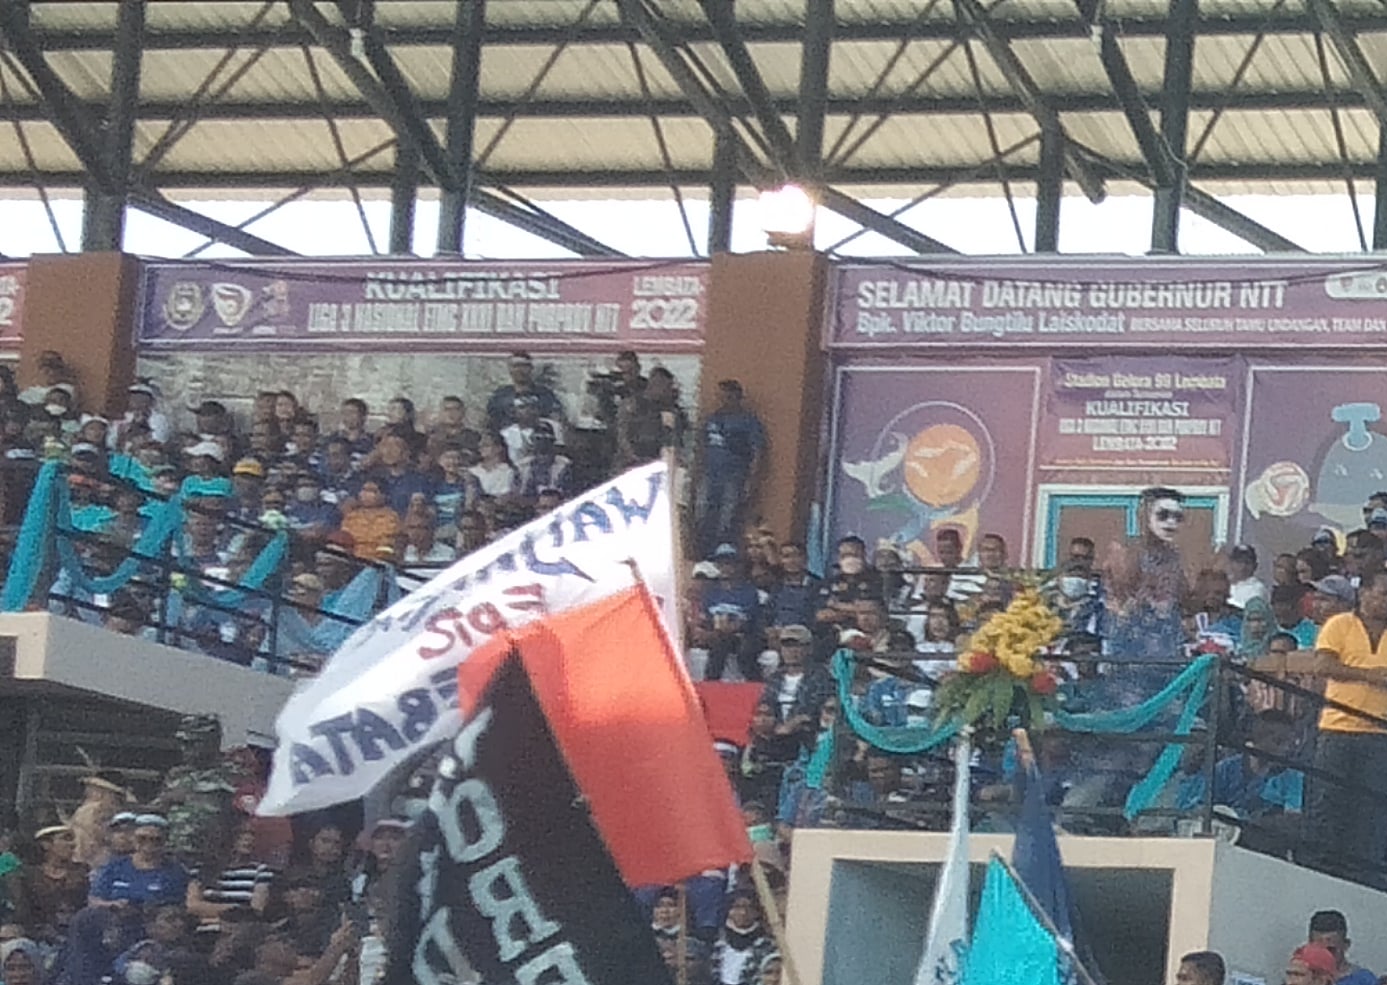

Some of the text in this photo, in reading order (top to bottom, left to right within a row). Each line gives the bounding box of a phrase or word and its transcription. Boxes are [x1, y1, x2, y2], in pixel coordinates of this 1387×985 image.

[366, 271, 560, 302] KUALIFIKASI
[857, 280, 1287, 310] SELAMAT DATANG GUBERNUR NTT
[629, 299, 699, 330] 2022
[902, 310, 955, 333] Viktor
[959, 311, 1034, 338] Bungtilu
[1038, 311, 1125, 334] Laiskodat
[1085, 400, 1190, 417] KUALIFIKASI
